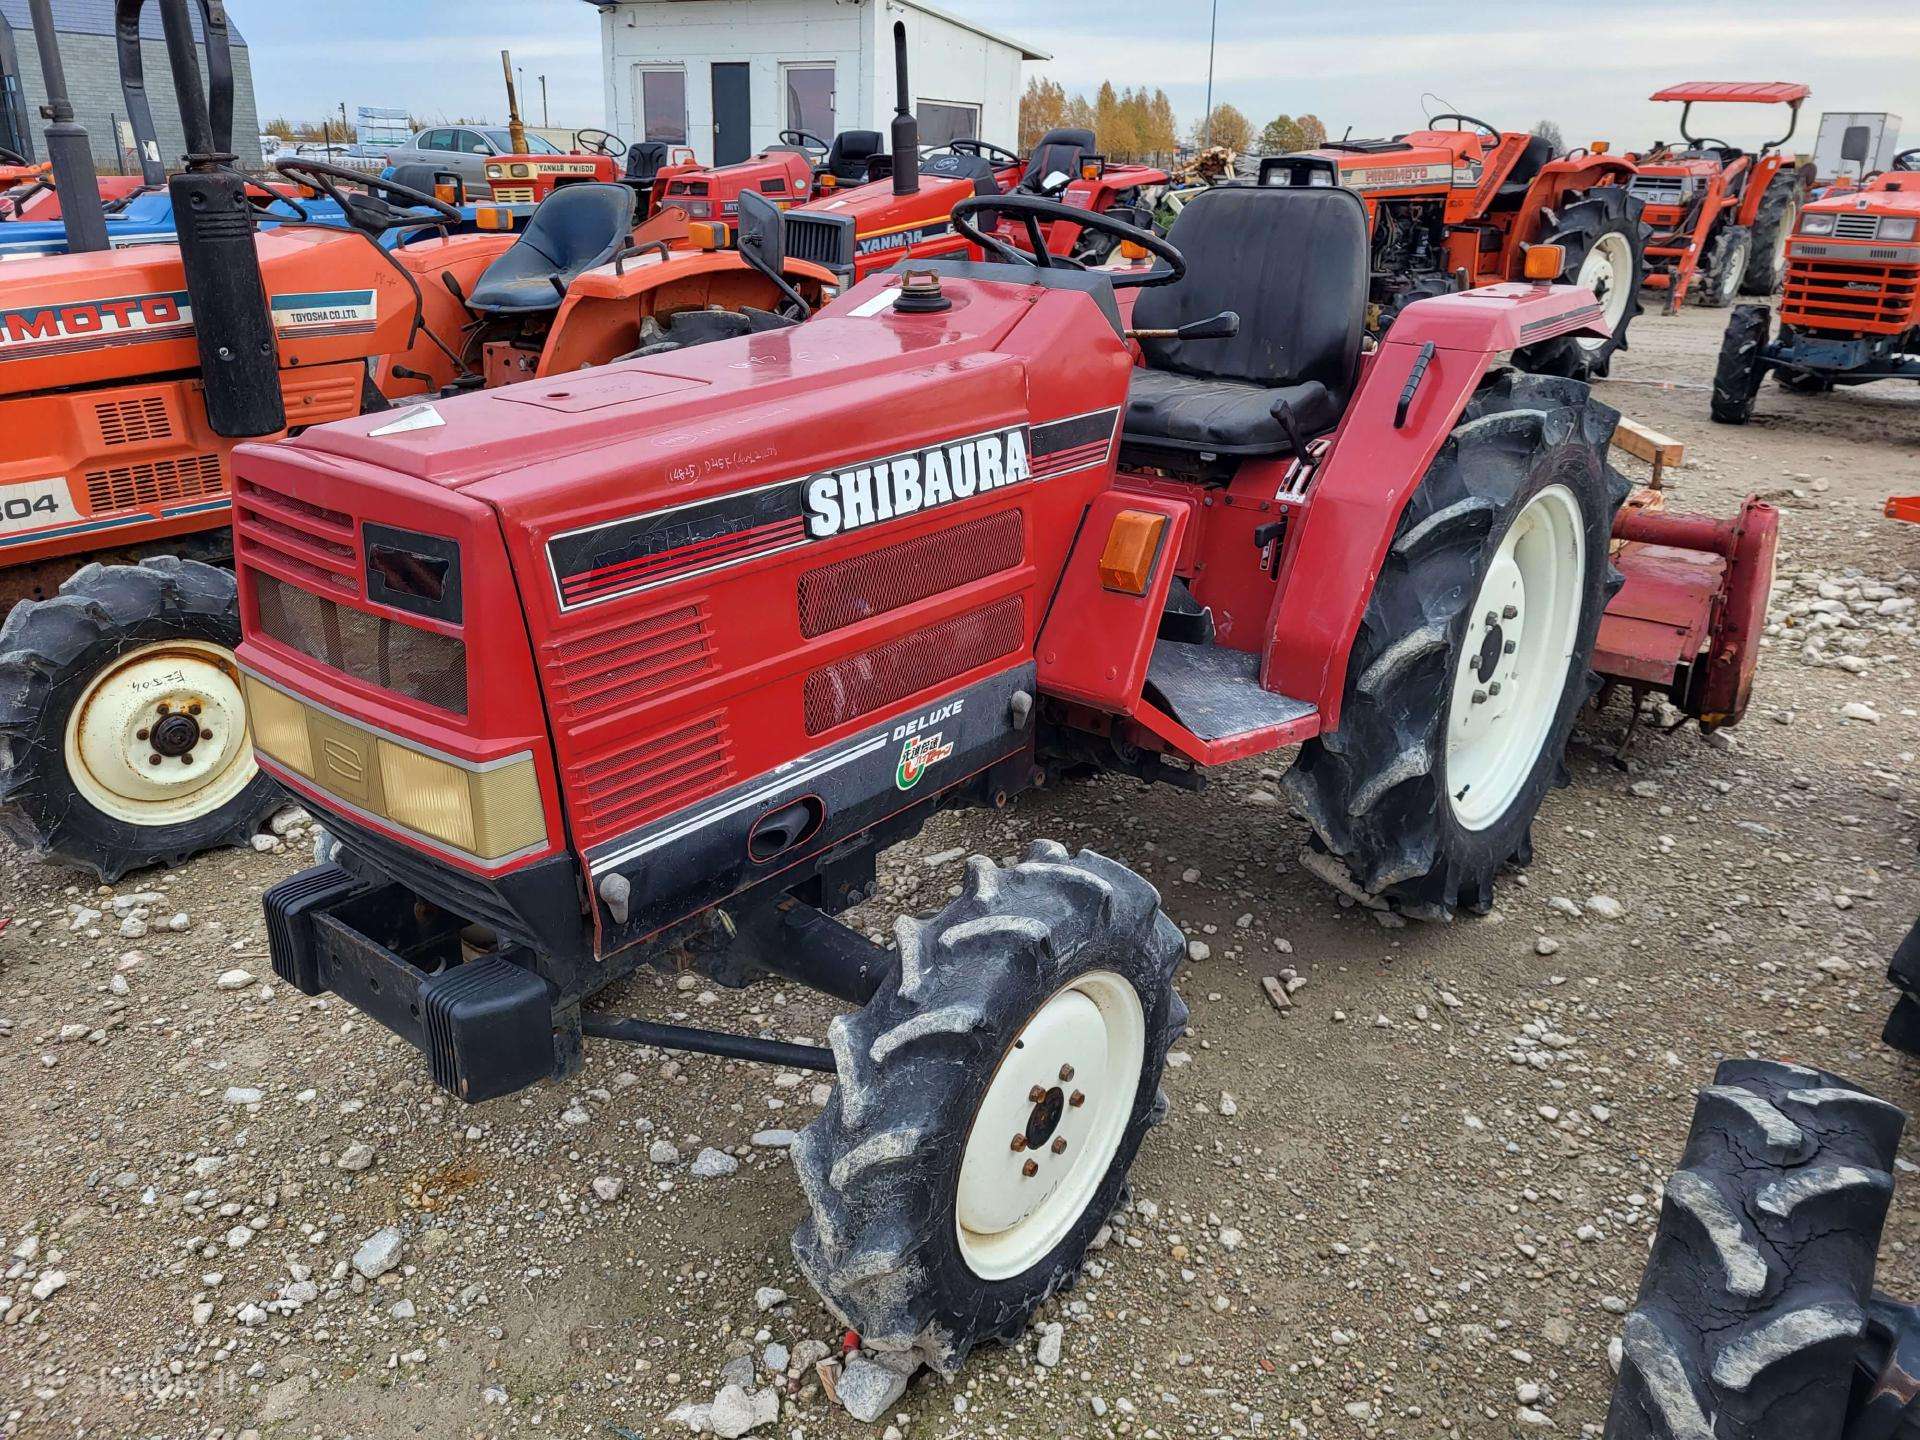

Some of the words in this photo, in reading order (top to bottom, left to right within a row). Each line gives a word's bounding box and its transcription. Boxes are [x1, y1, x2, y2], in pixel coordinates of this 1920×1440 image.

[539, 164, 564, 172] YANMAR
[861, 230, 923, 254] YANMAR
[0, 296, 181, 342] MOTO
[290, 311, 329, 322] TOYOSHA
[808, 430, 1030, 537] SHIBAURA
[0, 494, 59, 521] 04
[892, 699, 965, 742] DELUXE
